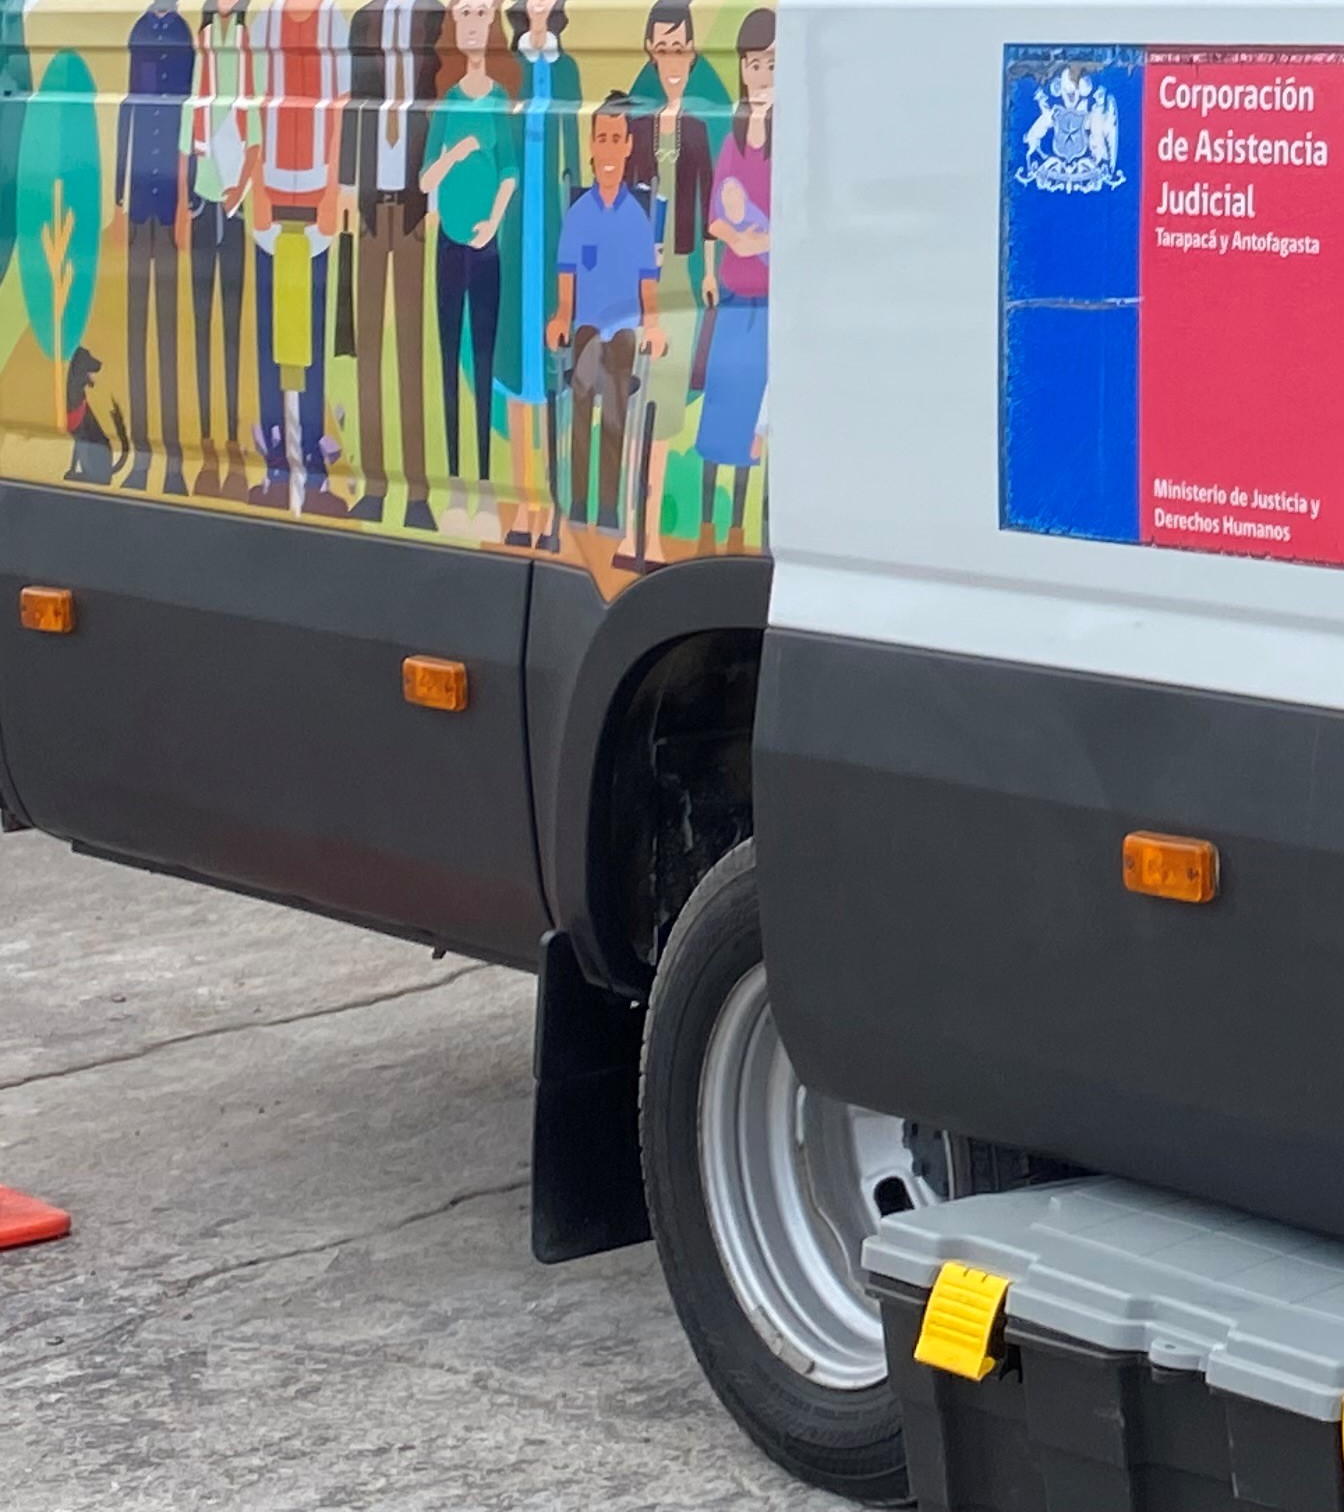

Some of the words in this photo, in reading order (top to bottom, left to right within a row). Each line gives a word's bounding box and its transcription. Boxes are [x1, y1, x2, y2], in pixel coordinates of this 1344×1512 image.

[1159, 75, 1315, 118] Corporación
[1157, 127, 1189, 162] de
[1194, 128, 1329, 167] Asistencia
[1156, 181, 1256, 218] Judicial
[1155, 227, 1217, 253] Tarapacá
[1219, 235, 1229, 255] y
[1232, 230, 1320, 258] Antofagasta
[1153, 478, 1227, 505] Ministerio
[1229, 486, 1249, 507] de
[1251, 488, 1308, 513] Justicia
[1310, 499, 1321, 520] y
[1154, 507, 1220, 534] Derechos
[1222, 515, 1291, 542] Humanos
